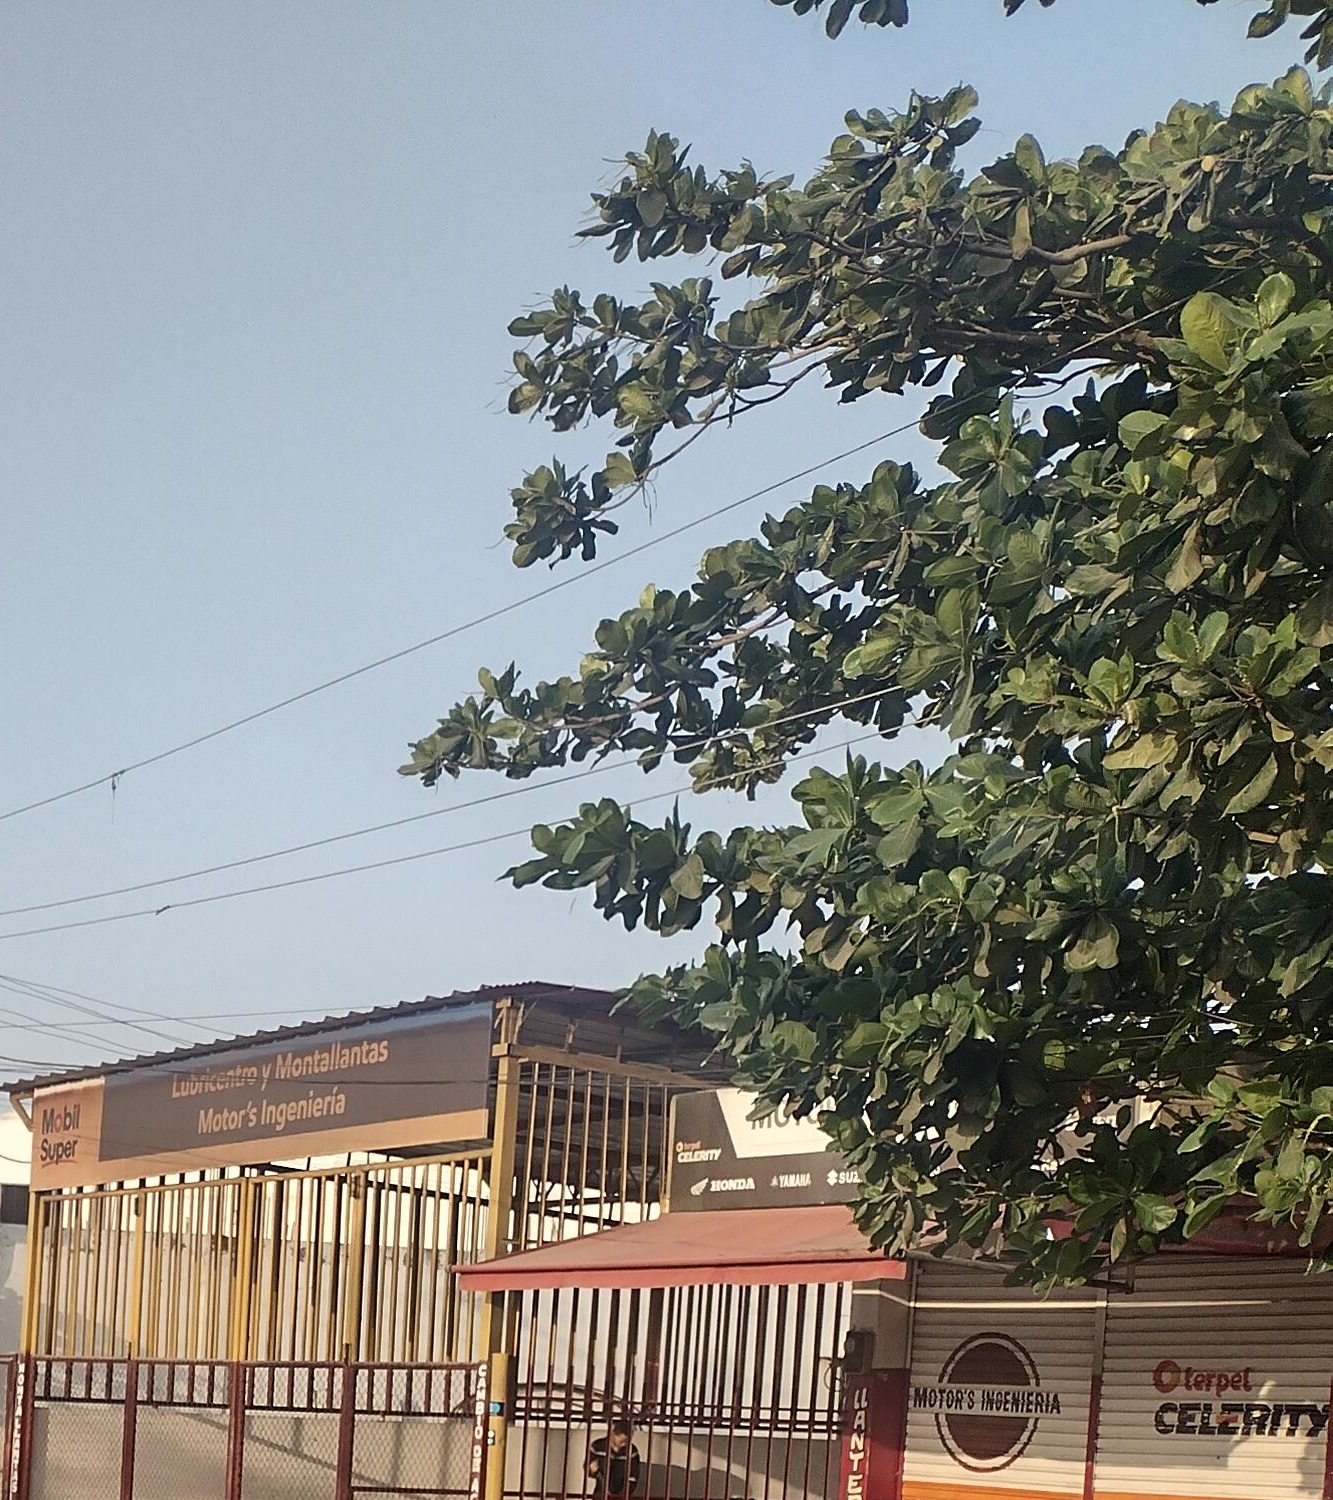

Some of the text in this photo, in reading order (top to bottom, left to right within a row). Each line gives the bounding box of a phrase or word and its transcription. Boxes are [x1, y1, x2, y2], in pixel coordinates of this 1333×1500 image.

[172, 1039, 389, 1098] Lubricentro y Montallantas
[42, 1104, 80, 1135] Mobil
[198, 1086, 346, 1134] Motor's Ingeniería
[40, 1138, 78, 1165] Super
[677, 1148, 722, 1163] CELERITY
[710, 1170, 864, 1192] HONDA YAMAHA SUZ
[1184, 1366, 1253, 1397] terpel
[474, 1364, 488, 1440] CAMBIO
[913, 1387, 1061, 1414] MOTOR'S INGENIERIA
[1154, 1402, 1330, 1437] CELERITY
[471, 1445, 482, 1473] DE
